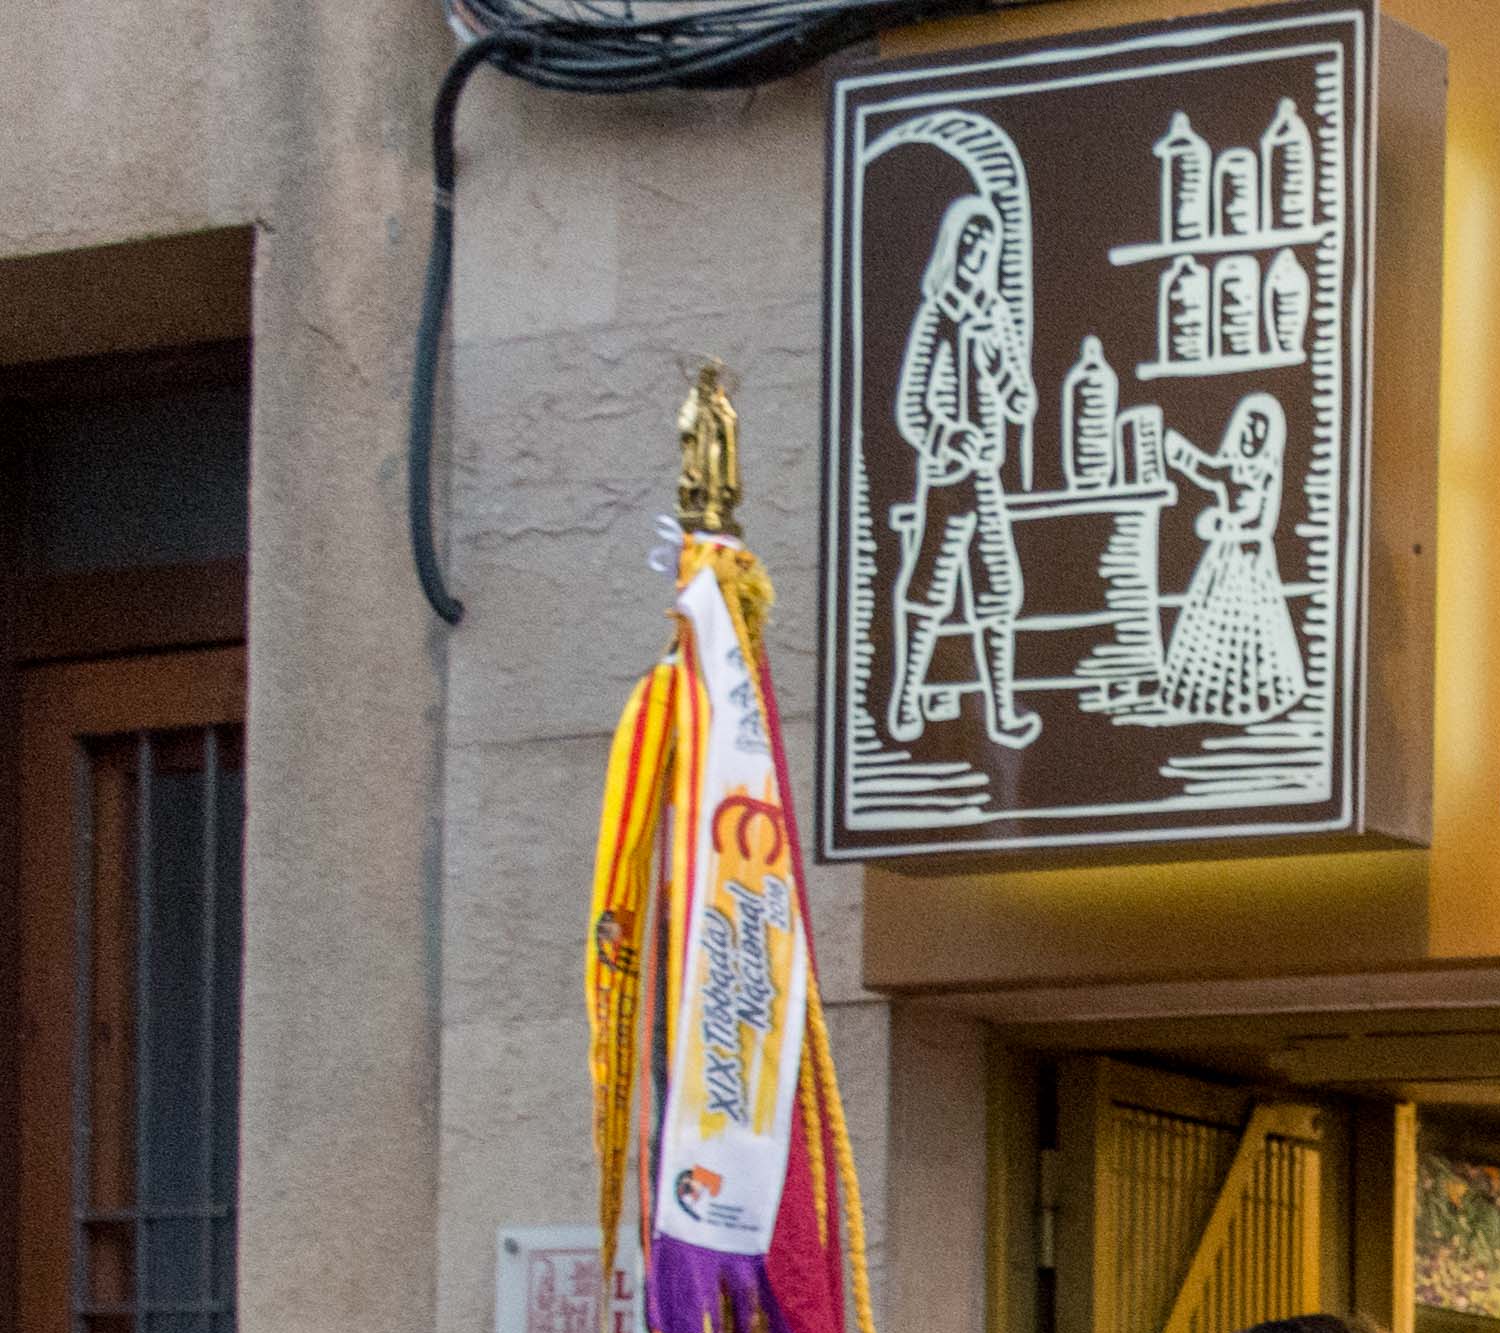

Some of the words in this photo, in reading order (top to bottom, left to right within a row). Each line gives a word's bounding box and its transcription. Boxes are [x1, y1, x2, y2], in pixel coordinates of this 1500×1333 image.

[727, 883, 766, 1029] Nacional
[708, 1052, 739, 1122] XIX
[614, 1270, 633, 1300] L
